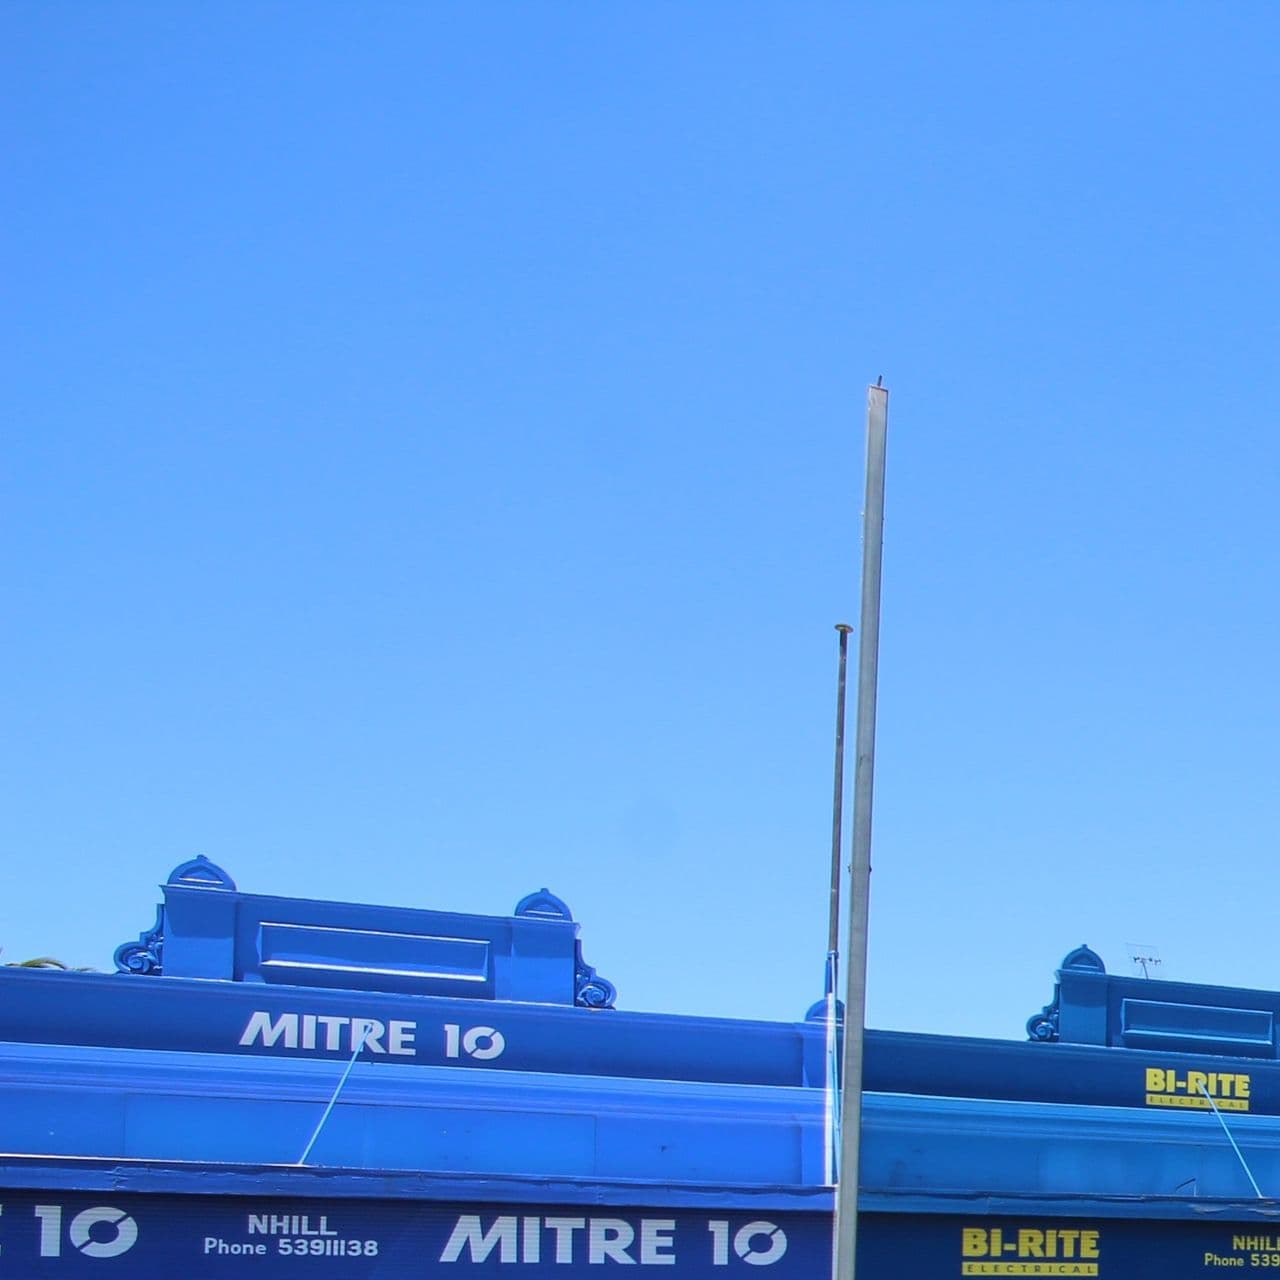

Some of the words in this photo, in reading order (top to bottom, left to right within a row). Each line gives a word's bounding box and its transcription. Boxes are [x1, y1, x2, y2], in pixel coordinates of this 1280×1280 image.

[239, 1011, 417, 1056] MITRE
[444, 1024, 506, 1060] 10
[1145, 1067, 1251, 1098] BI-RITE
[1149, 1096, 1244, 1109] ELECTRCAL
[34, 1205, 139, 1258] 10
[248, 1215, 338, 1236] NHILL
[204, 1238, 267, 1256] Phone
[278, 1239, 379, 1257] 53911138
[439, 1215, 676, 1265] MITRE
[708, 1220, 788, 1266] 10
[962, 1227, 1100, 1258] BI-RITE
[967, 1264, 1094, 1274] ELECTRICAL
[1204, 1253, 1245, 1267] Phone
